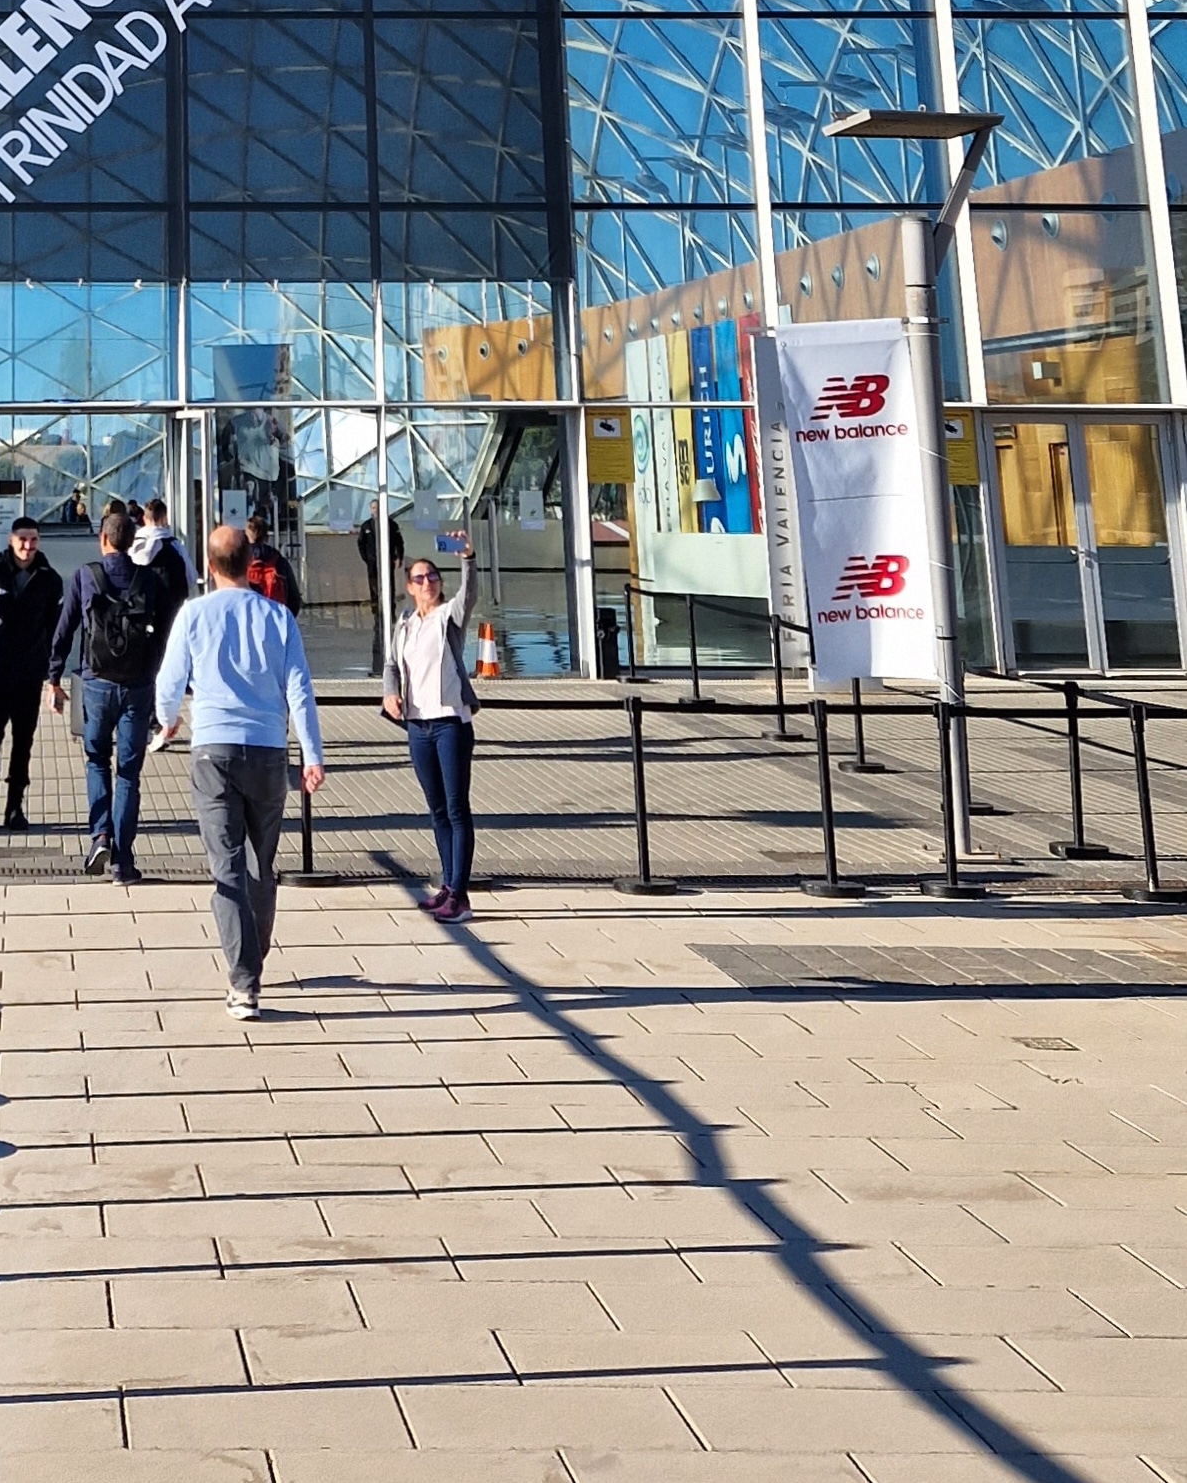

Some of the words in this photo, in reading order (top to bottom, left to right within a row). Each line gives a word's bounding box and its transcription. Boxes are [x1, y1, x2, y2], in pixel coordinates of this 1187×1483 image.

[699, 366, 716, 482] URICH
[795, 428, 830, 443] new
[834, 422, 908, 440] balance
[770, 421, 792, 547] VALENCIA
[817, 607, 851, 624] new
[854, 604, 925, 621] balance
